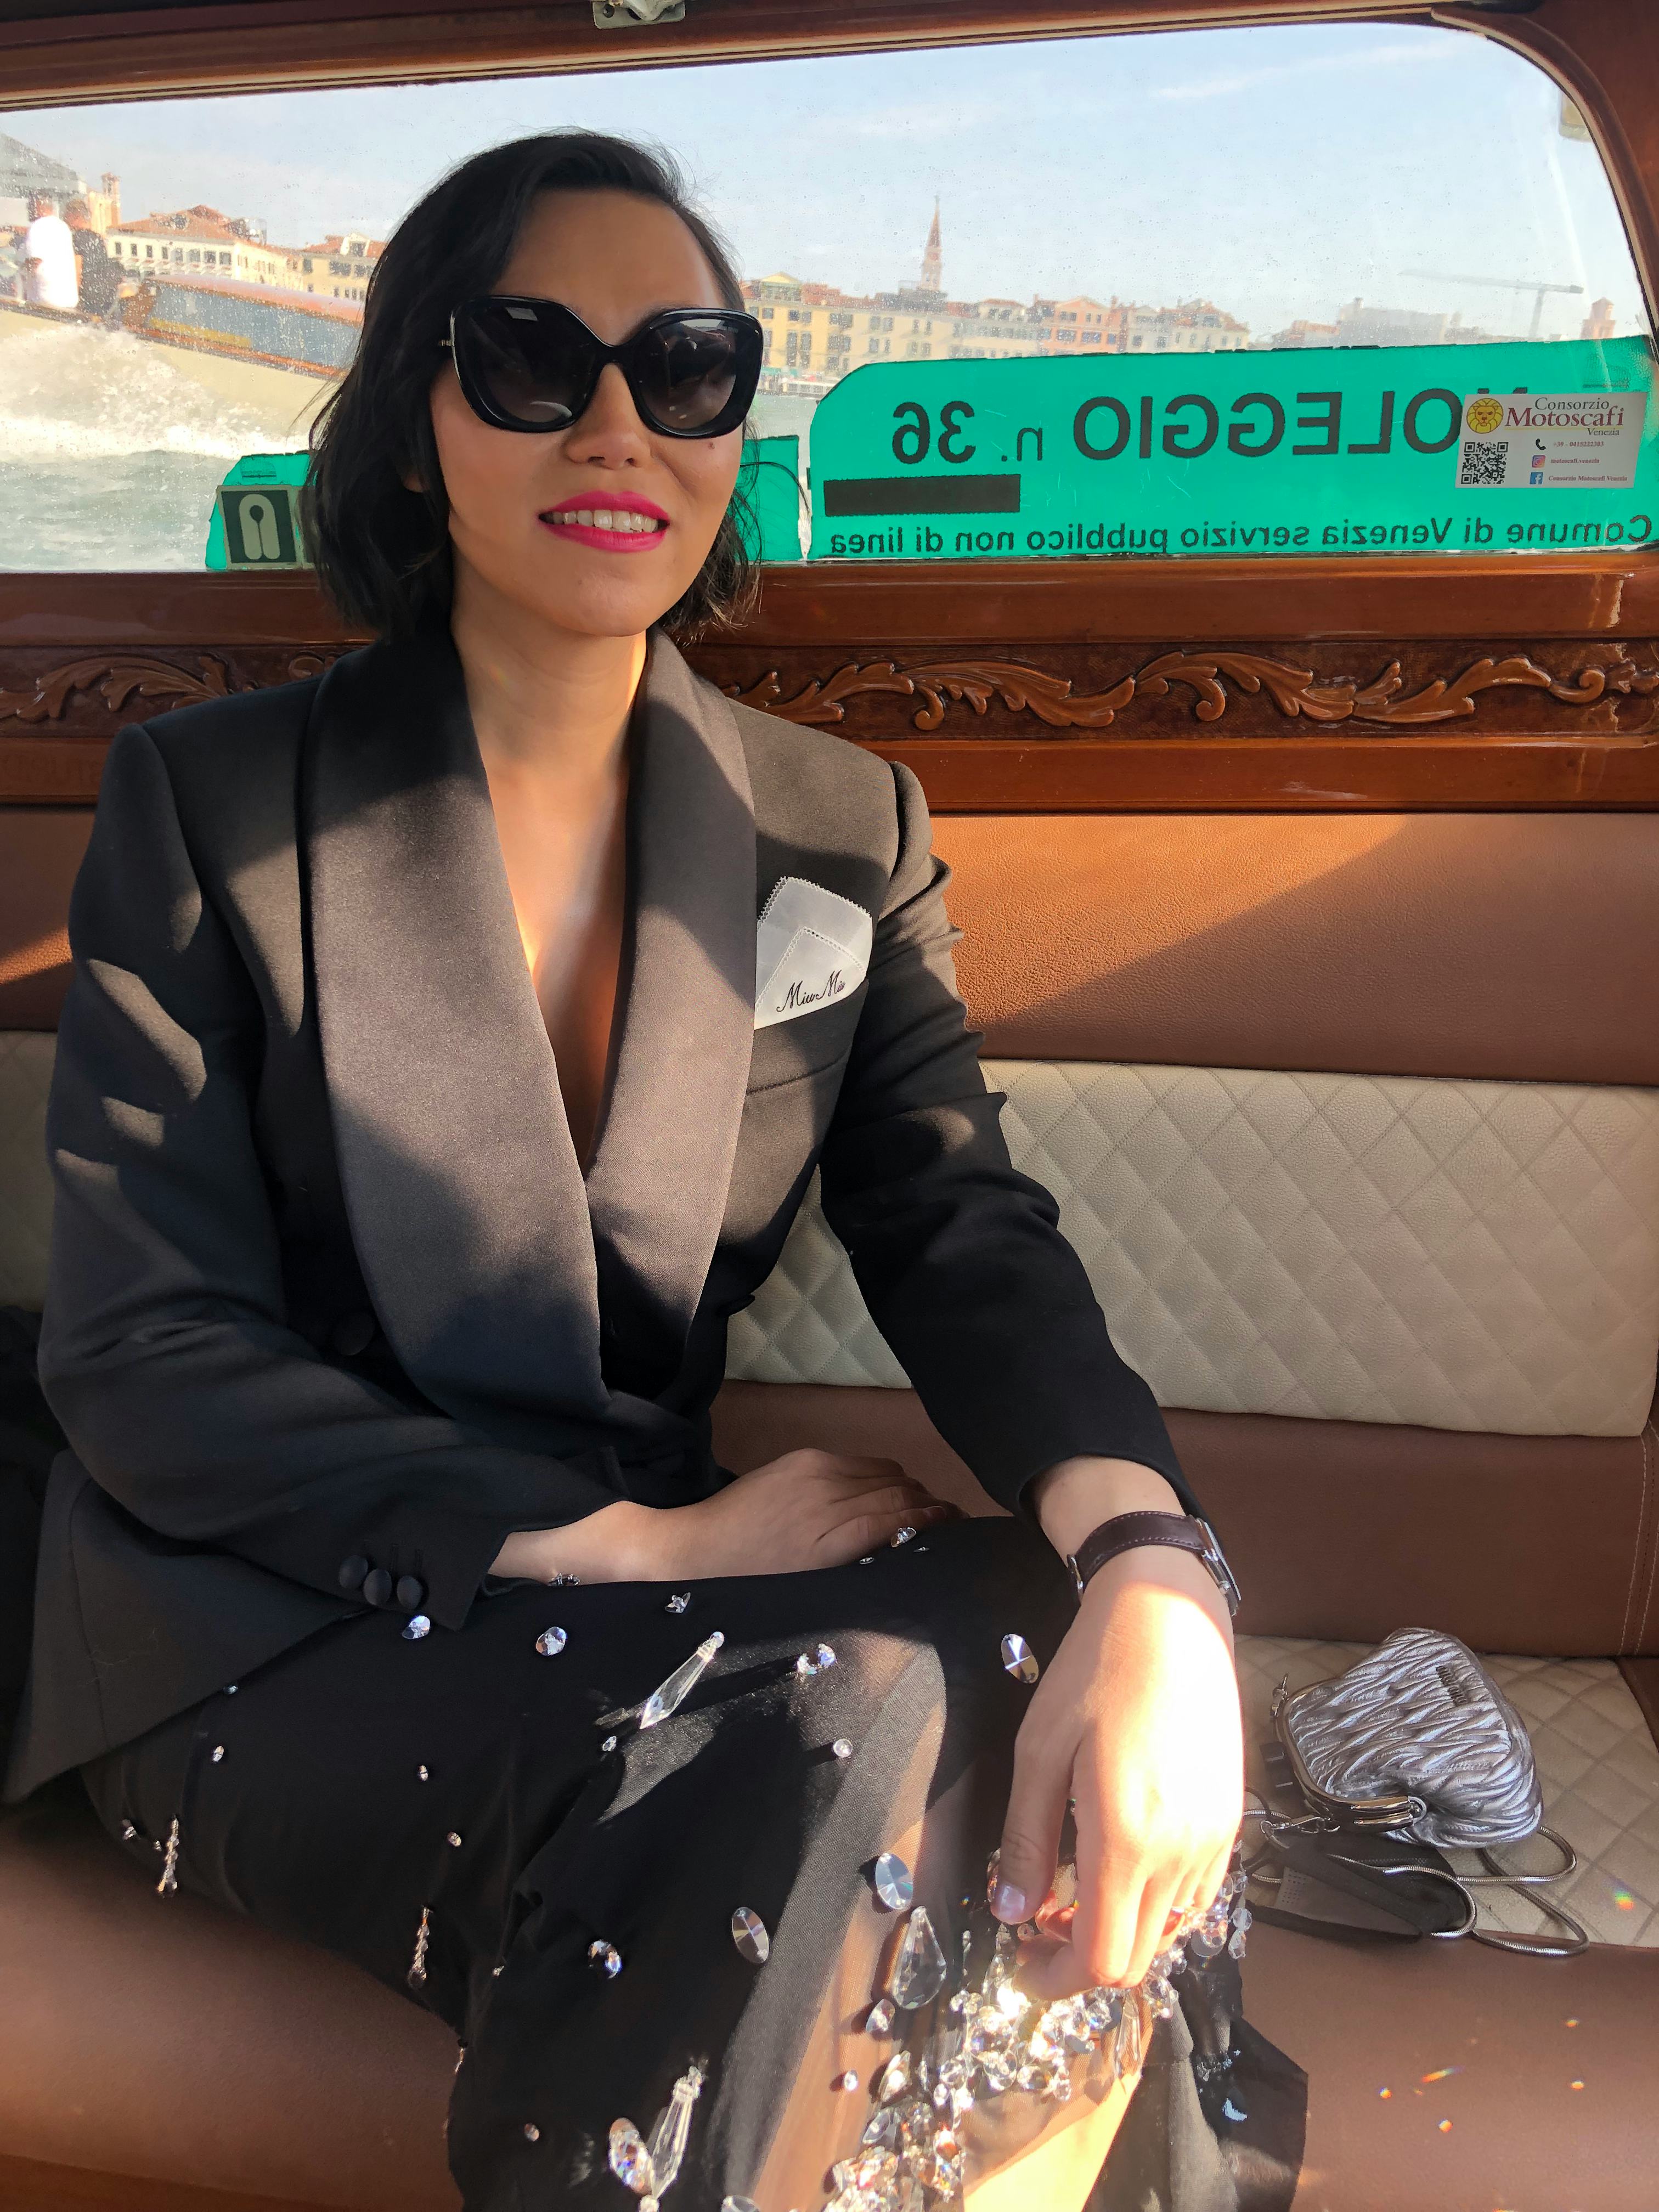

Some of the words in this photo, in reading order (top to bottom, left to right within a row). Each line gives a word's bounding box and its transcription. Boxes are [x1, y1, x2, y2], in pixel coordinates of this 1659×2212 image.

[1534, 397, 1610, 410] Consorzio
[1504, 405, 1624, 427] Motoscafi
[1587, 427, 1620, 436] Venezia
[776, 980, 816, 1012] Miu
